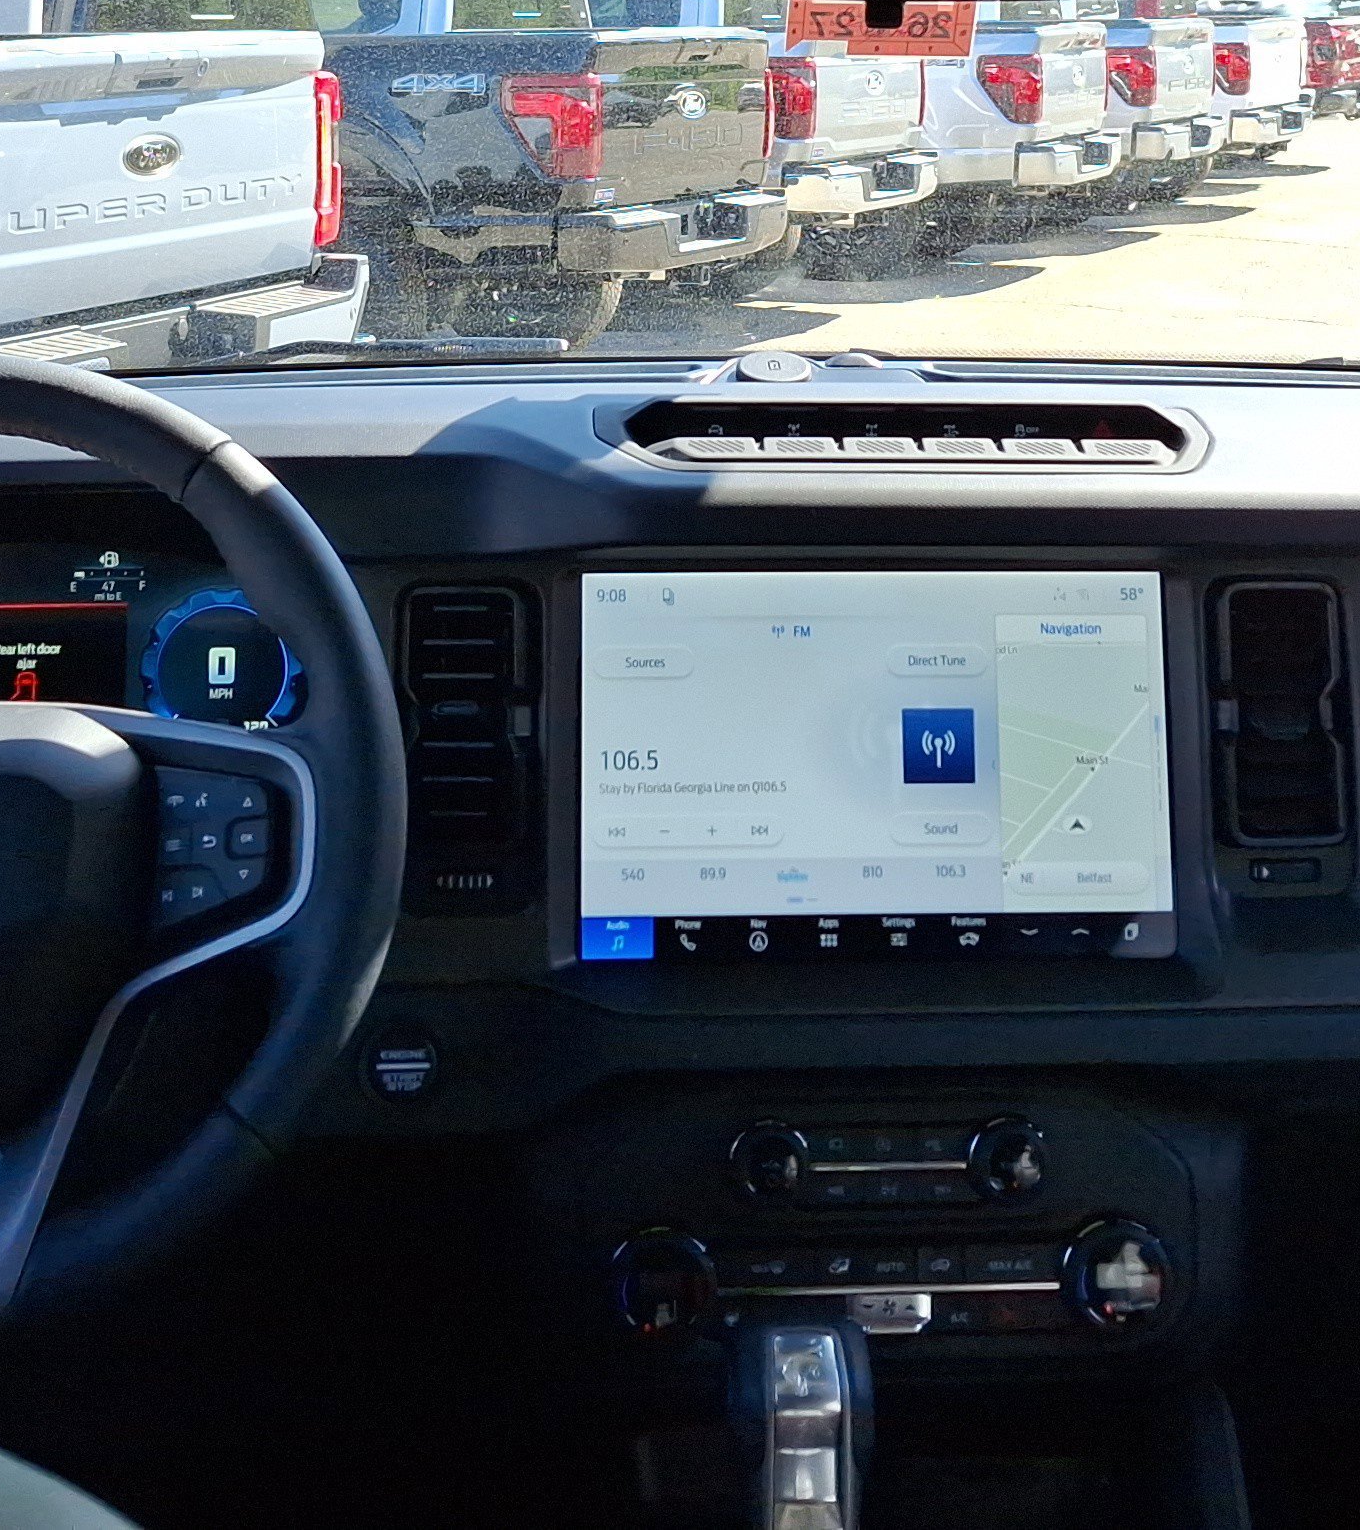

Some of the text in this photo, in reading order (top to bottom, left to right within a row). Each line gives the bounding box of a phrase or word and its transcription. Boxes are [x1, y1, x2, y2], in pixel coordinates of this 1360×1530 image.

[181, 173, 302, 213] DUTY
[70, 581, 77, 592] E
[101, 580, 115, 591] 47
[138, 580, 146, 591] F
[597, 589, 627, 602] 9:08
[1120, 587, 1144, 601] 58°
[793, 625, 811, 637] FM
[1040, 623, 1102, 637] Navigation
[17, 643, 36, 656] left
[37, 643, 62, 655] door
[16, 657, 37, 671] ajar
[209, 647, 236, 684] 0
[625, 657, 666, 669] Sources
[908, 654, 966, 666] Direct Tune
[209, 688, 234, 699] MPH
[600, 750, 659, 771] 106.5
[1076, 756, 1097, 765] Main
[599, 781, 787, 795] Stay by Florida Georgia Line on Q106.5
[924, 823, 958, 835] Sound
[621, 868, 645, 881] 540
[700, 867, 726, 881] 89.9
[936, 865, 966, 878] 106.3
[1020, 873, 1034, 884] NE
[1077, 873, 1112, 884] Belfast
[675, 919, 702, 931] Phone
[750, 919, 768, 930] Nav
[818, 918, 840, 930] Apps
[881, 917, 916, 929] Settings
